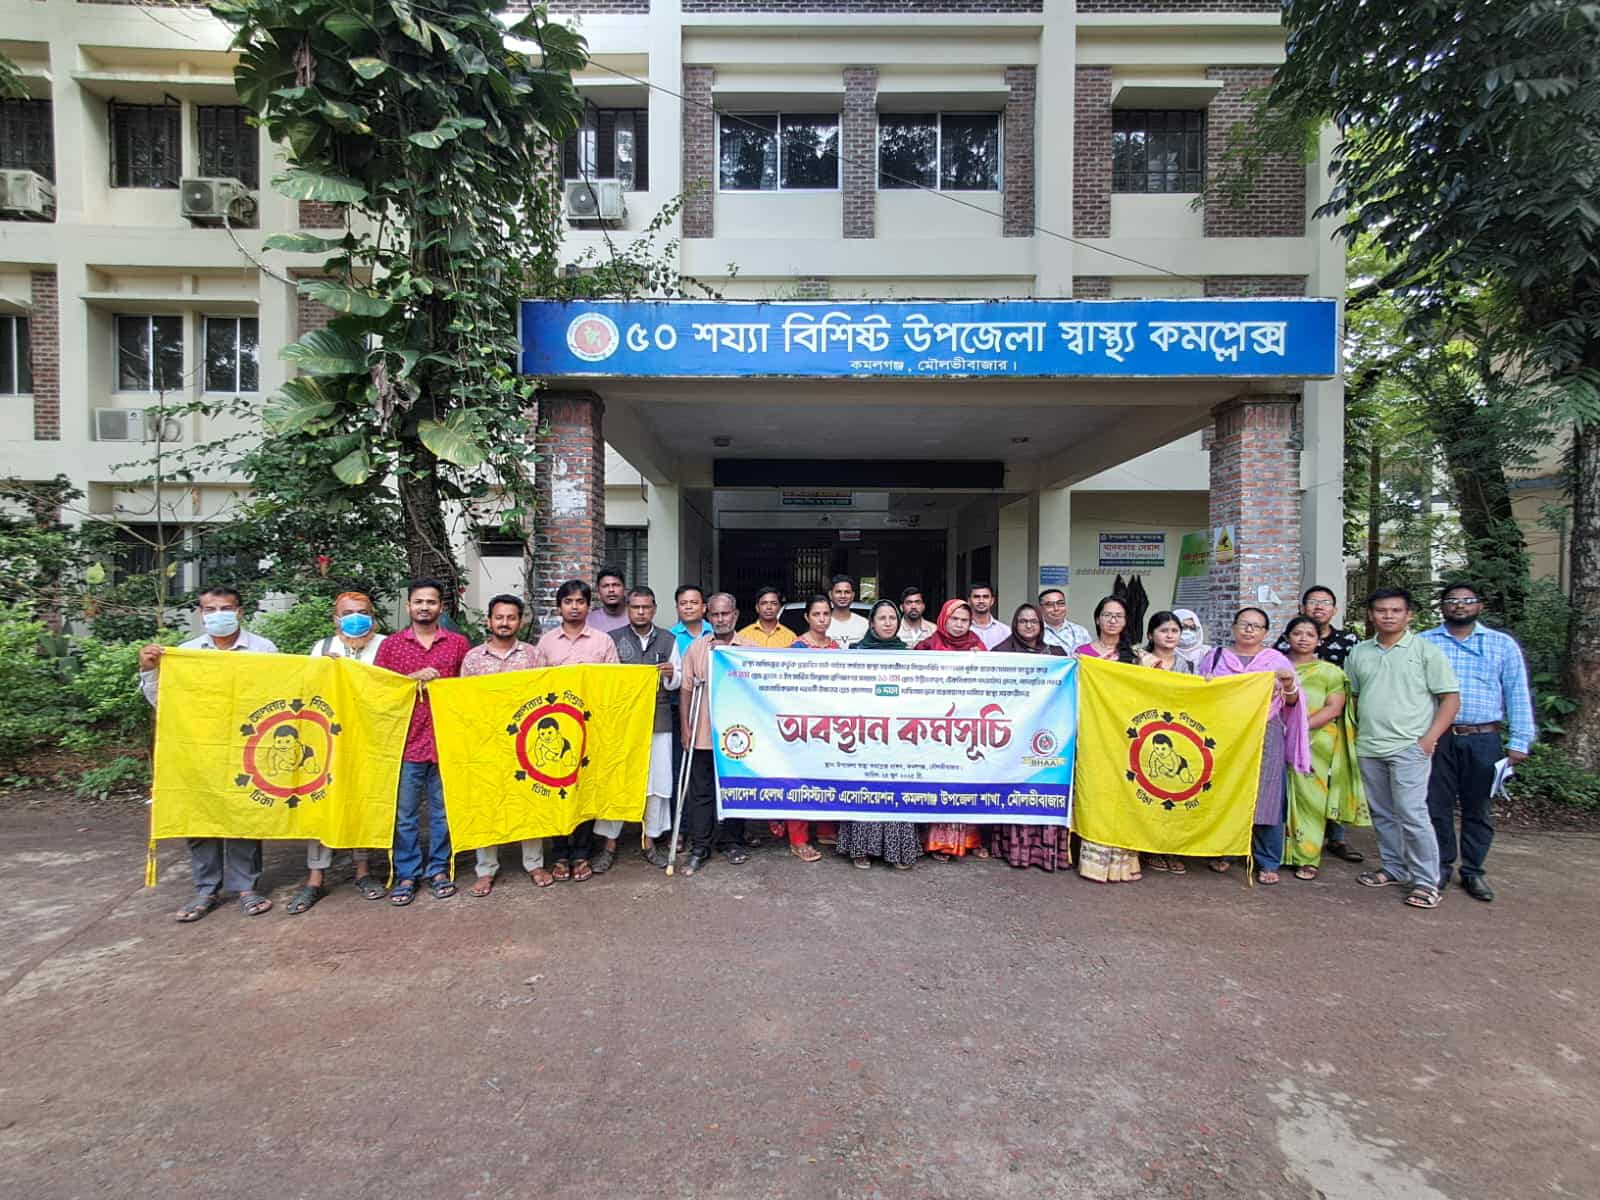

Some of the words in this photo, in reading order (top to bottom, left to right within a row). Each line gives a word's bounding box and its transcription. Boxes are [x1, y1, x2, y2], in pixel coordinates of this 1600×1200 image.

[626, 322, 677, 352] ৫০
[692, 322, 771, 353] শয্যা
[782, 311, 893, 353] বিশিষ্ট
[903, 314, 1047, 353] উপজেলা
[1058, 321, 1137, 363] স্বাস্থ্য
[1149, 321, 1288, 363] কমপ্লেক্স
[775, 714, 891, 754] অবস্থান
[896, 702, 1013, 761] কর্মসূচি
[940, 789, 978, 806] উপজেলা
[1007, 788, 1067, 808] মৌলভীবাজার
